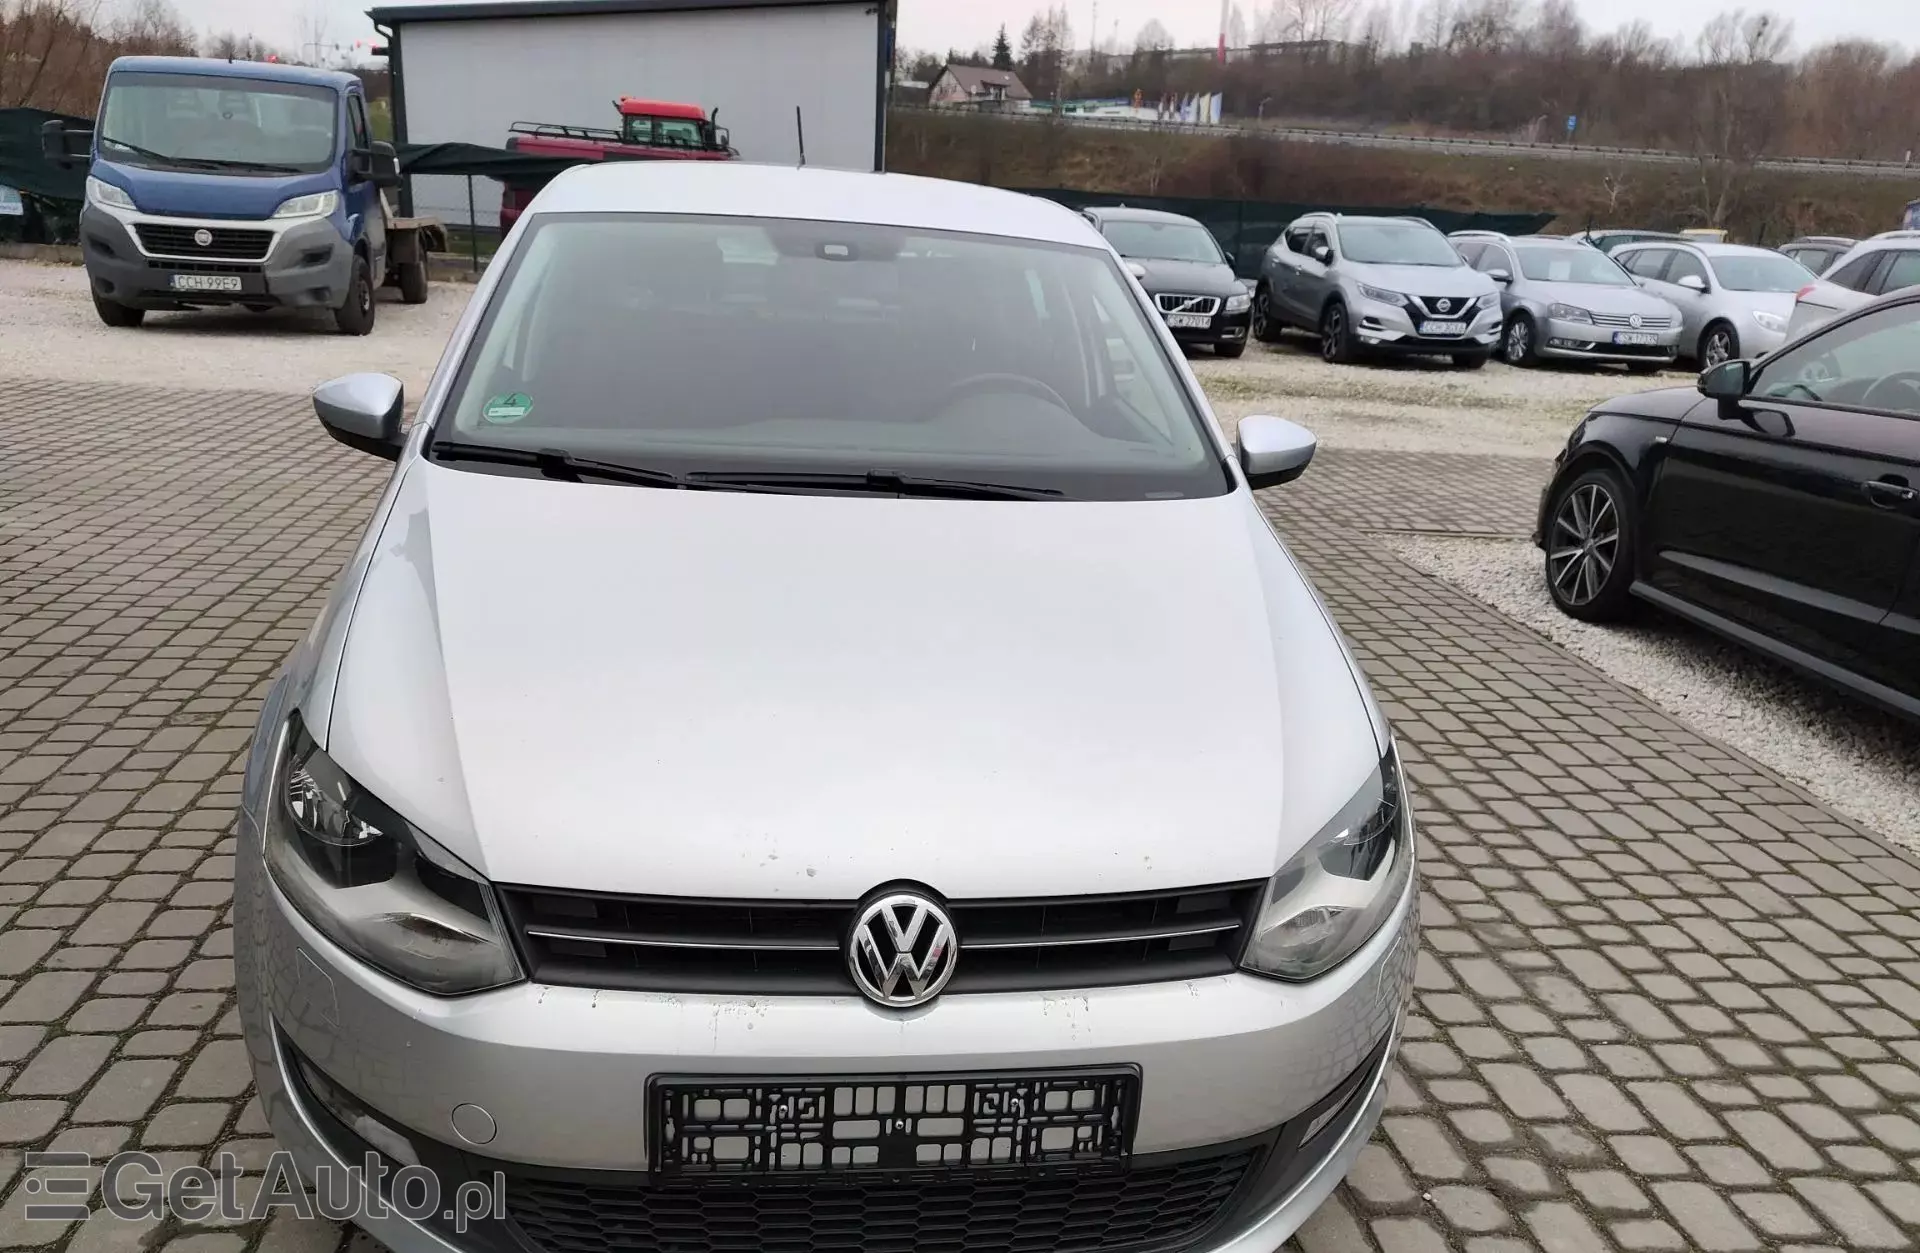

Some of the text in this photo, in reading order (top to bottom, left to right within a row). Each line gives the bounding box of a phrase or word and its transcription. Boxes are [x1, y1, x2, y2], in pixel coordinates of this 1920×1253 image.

[179, 276, 238, 290] CCH 99E9
[502, 393, 516, 407] 4
[848, 894, 957, 1007] VW
